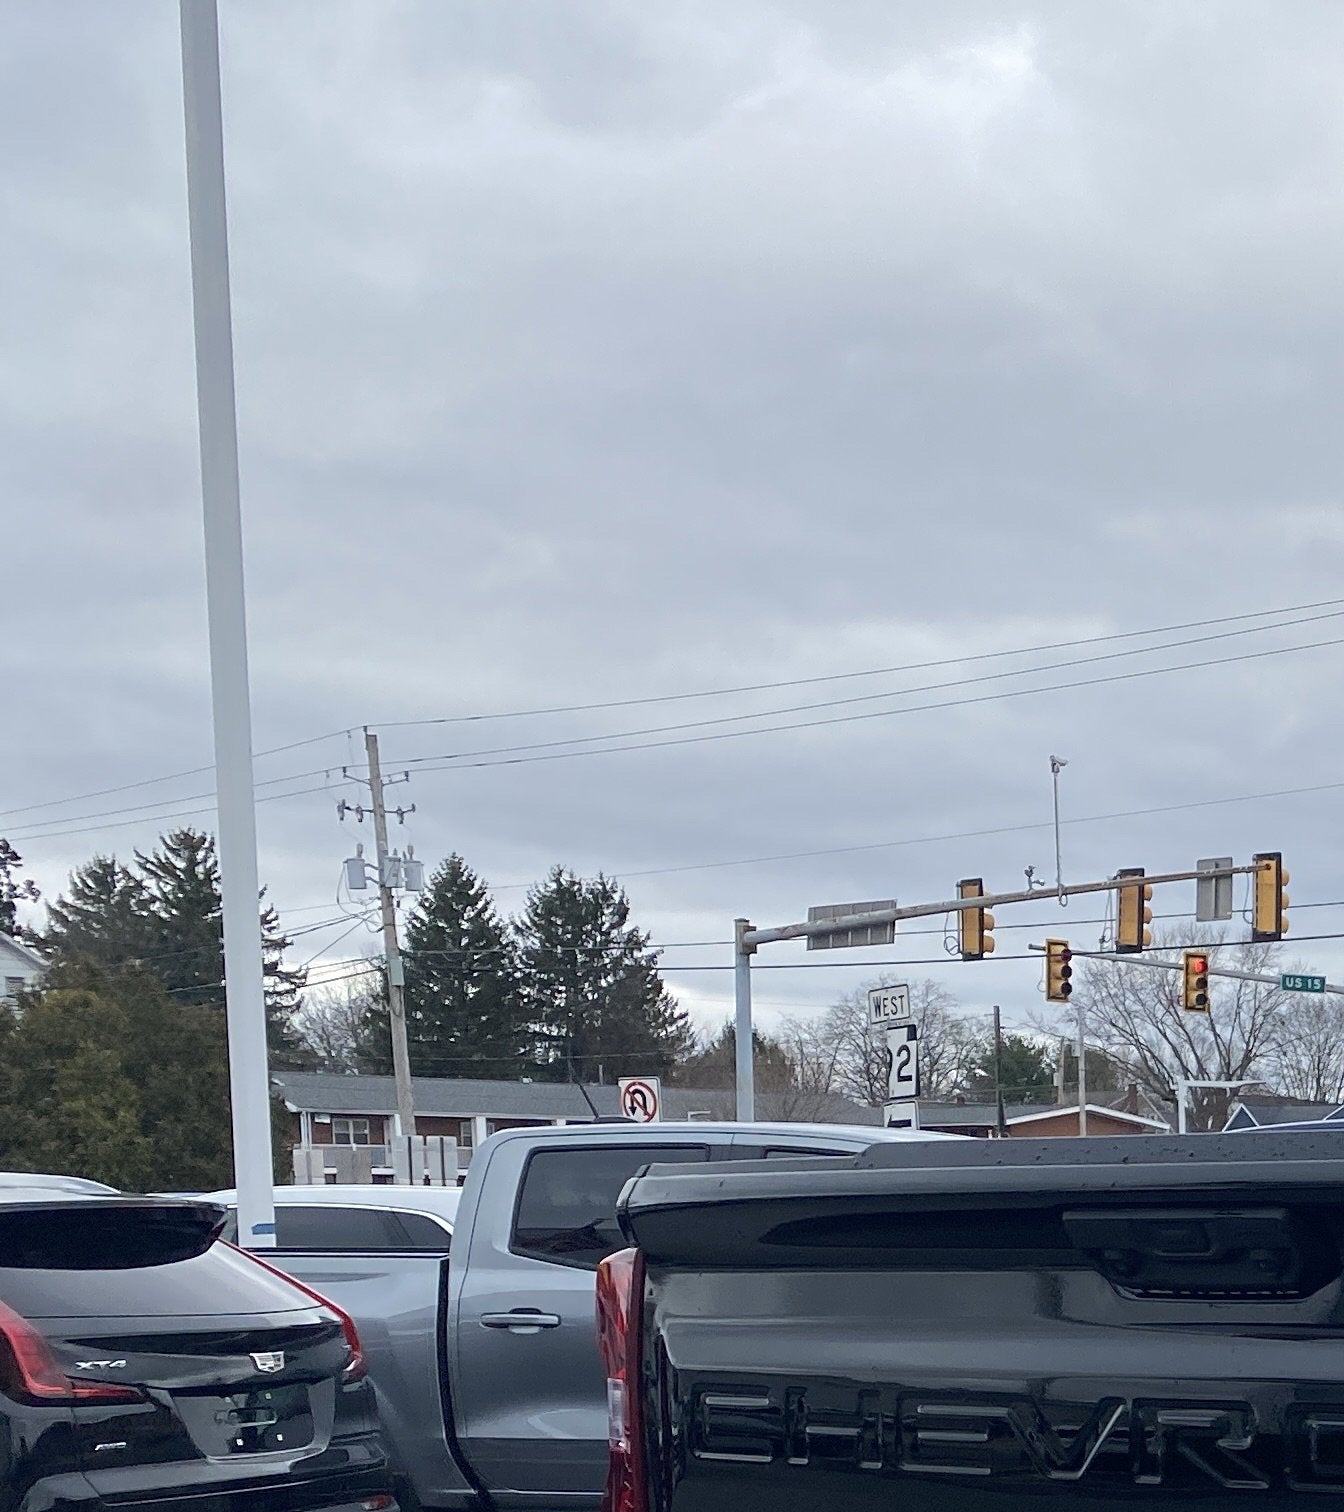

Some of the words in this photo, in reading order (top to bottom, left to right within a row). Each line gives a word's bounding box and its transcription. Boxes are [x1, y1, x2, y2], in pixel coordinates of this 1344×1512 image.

[1285, 976, 1303, 989] US
[1307, 978, 1321, 990] 15
[872, 994, 905, 1018] WEST
[75, 1359, 127, 1371] XT4
